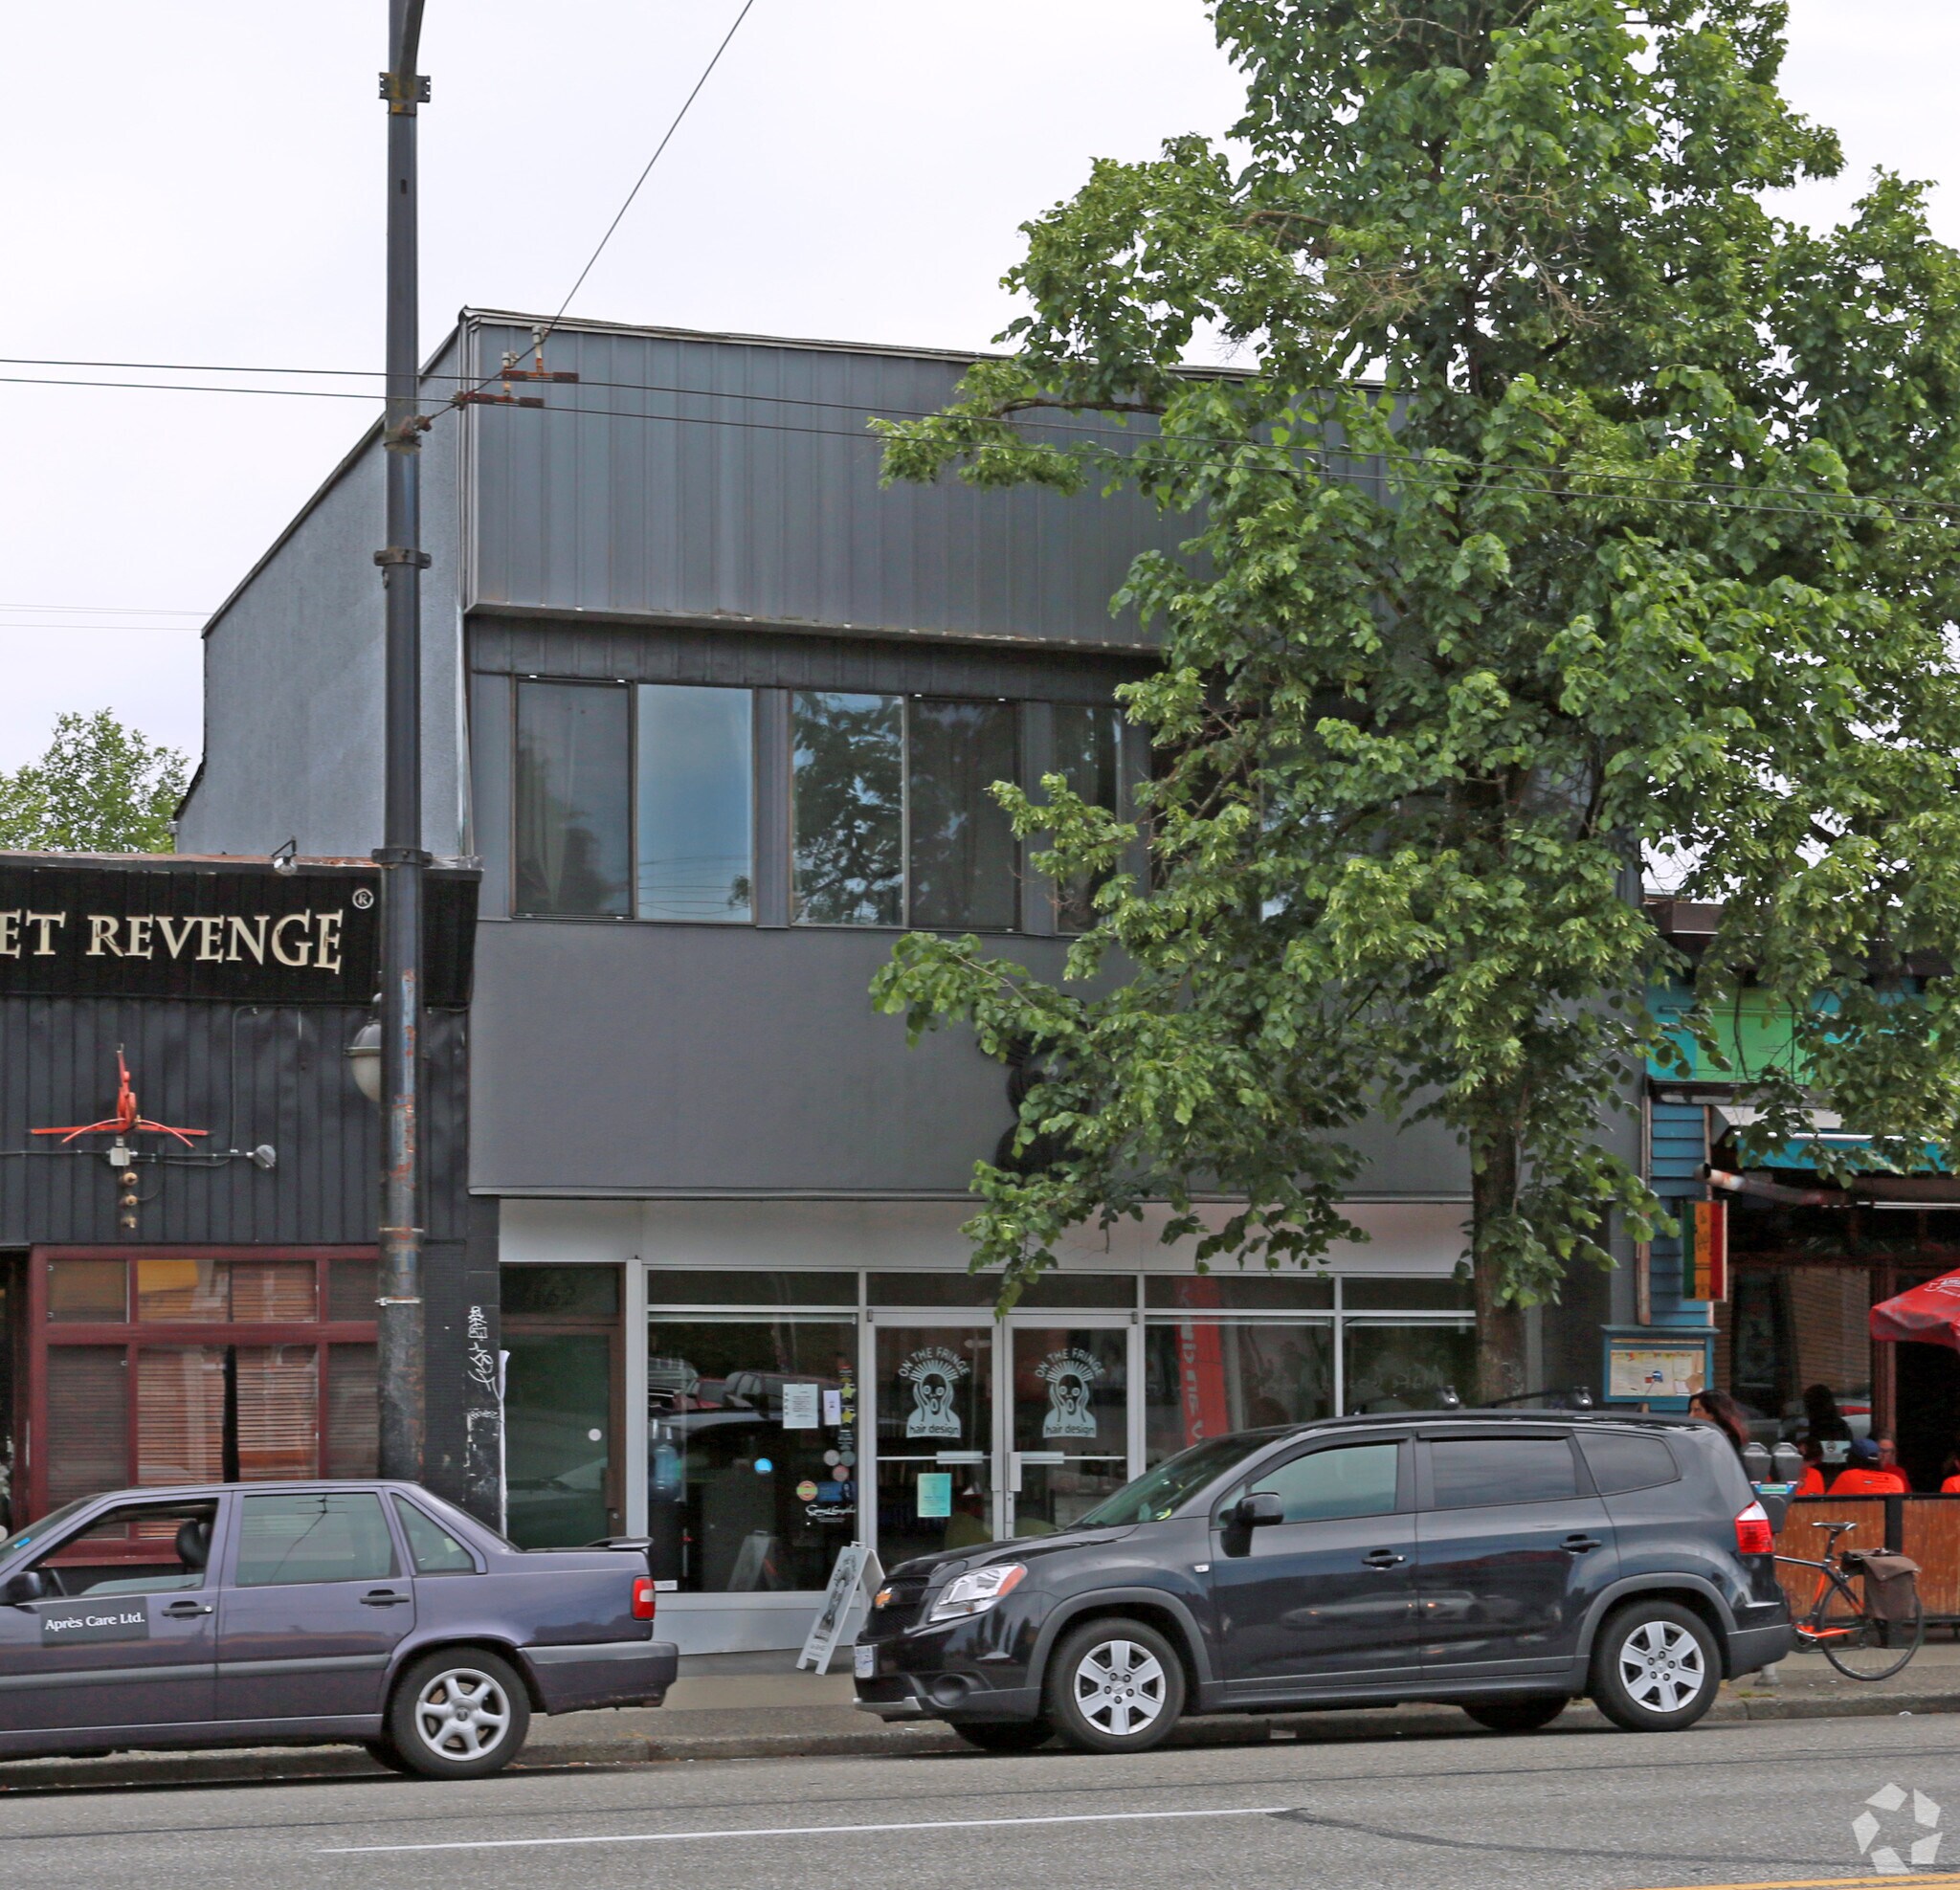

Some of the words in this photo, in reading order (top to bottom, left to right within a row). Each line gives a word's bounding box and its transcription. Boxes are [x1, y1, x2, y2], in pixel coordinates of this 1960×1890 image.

[85, 908, 344, 975] REVENGE
[898, 1360, 913, 1377] ON
[911, 1346, 933, 1362] THE
[936, 1346, 970, 1376] FRINGE
[1035, 1361, 1049, 1377] ON
[1047, 1347, 1069, 1363] THE
[1072, 1347, 1105, 1377] FRINGE
[909, 1423, 926, 1434] hair
[928, 1423, 959, 1436] design
[1045, 1423, 1062, 1434] hair
[1064, 1423, 1094, 1436] design
[45, 1617, 83, 1633] Après
[86, 1615, 117, 1627] Care
[121, 1612, 145, 1625] Ltd.
